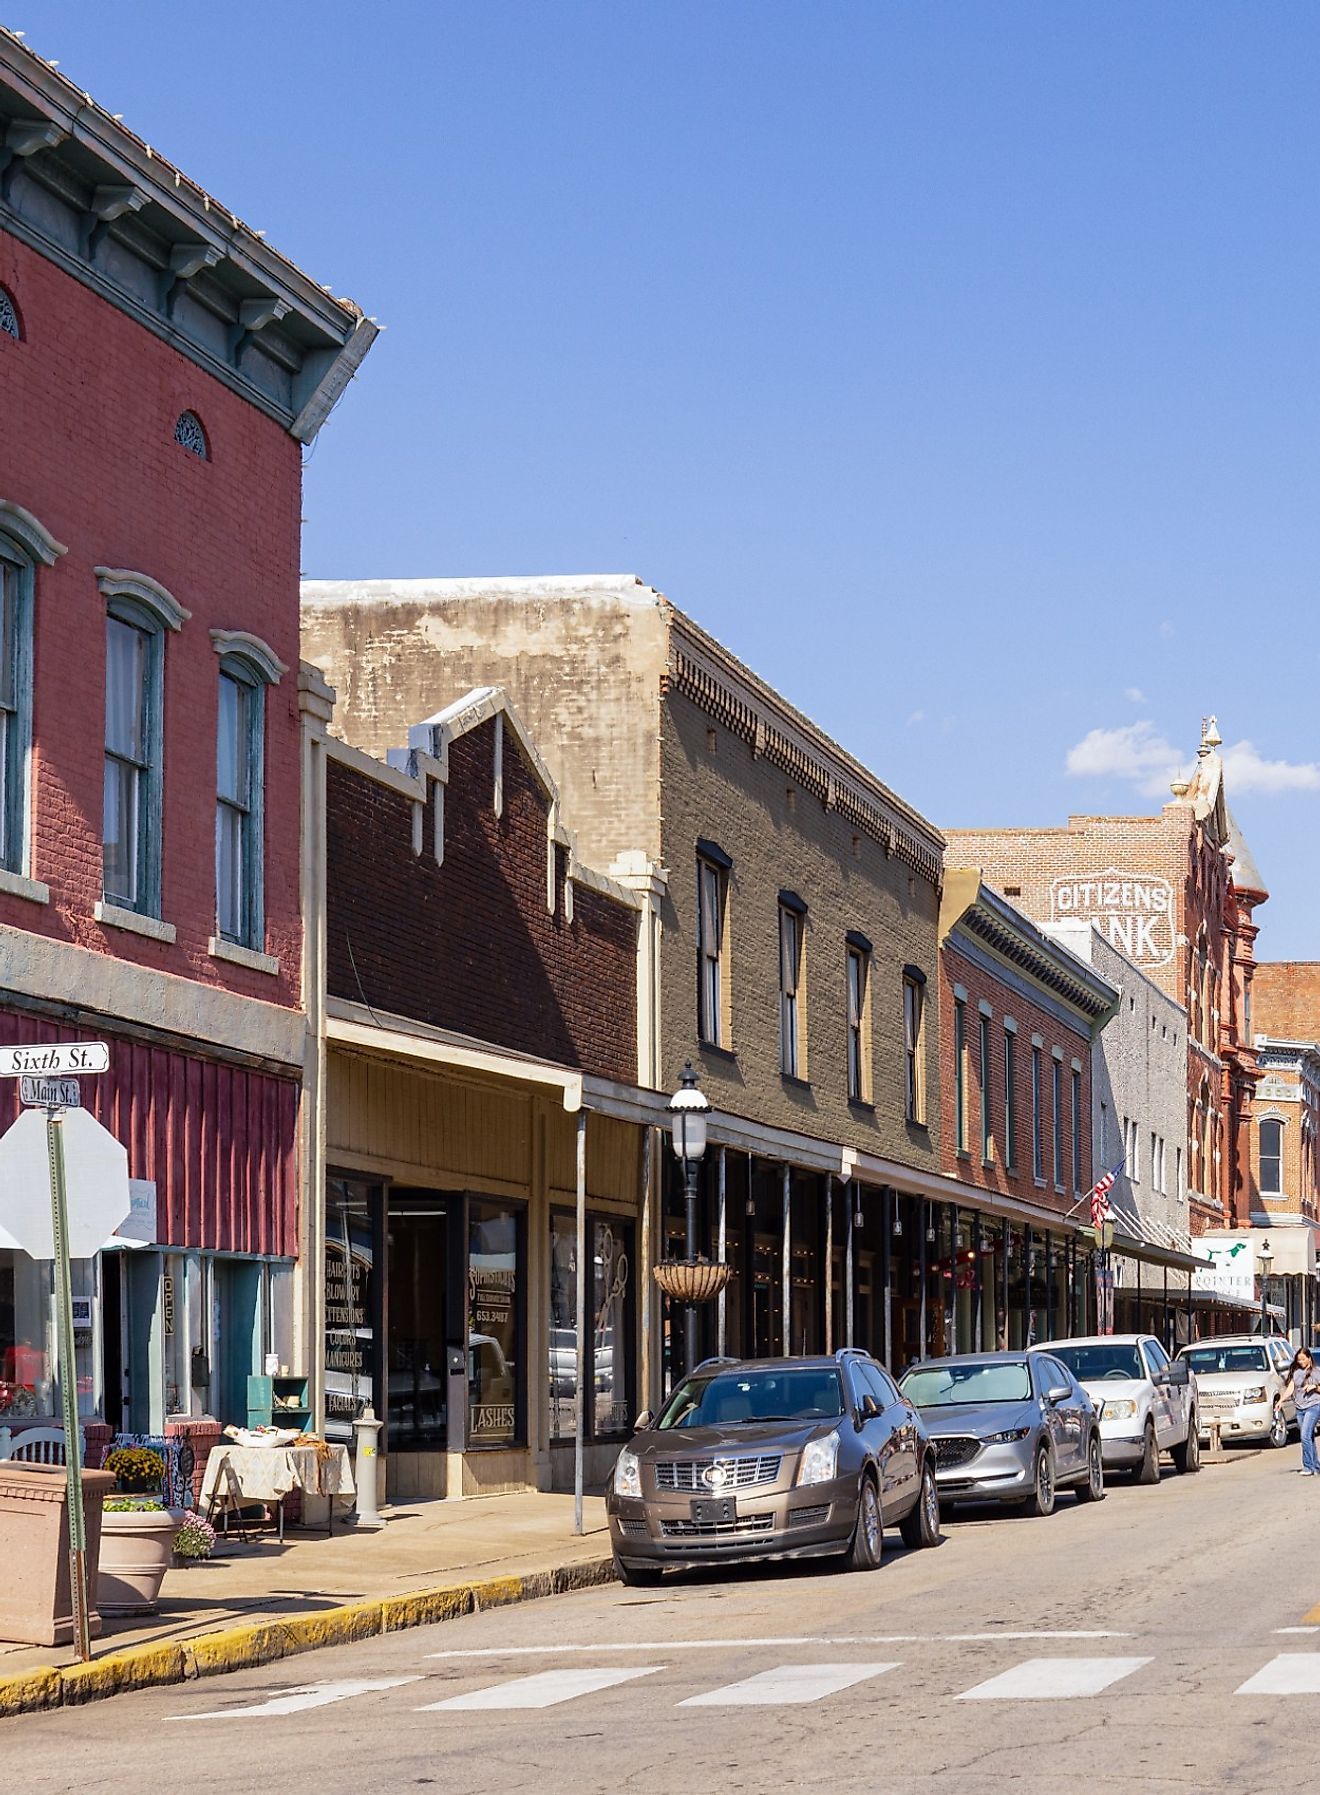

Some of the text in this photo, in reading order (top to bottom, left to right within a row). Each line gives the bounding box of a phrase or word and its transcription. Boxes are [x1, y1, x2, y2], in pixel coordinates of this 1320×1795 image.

[1058, 883, 1169, 911] CITIZENS
[1091, 915, 1162, 957] NK
[12, 1048, 93, 1070] Sixth St.
[30, 1080, 72, 1104] Main St.
[164, 1280, 174, 1334] OPEN
[470, 1408, 515, 1433] LASHES
